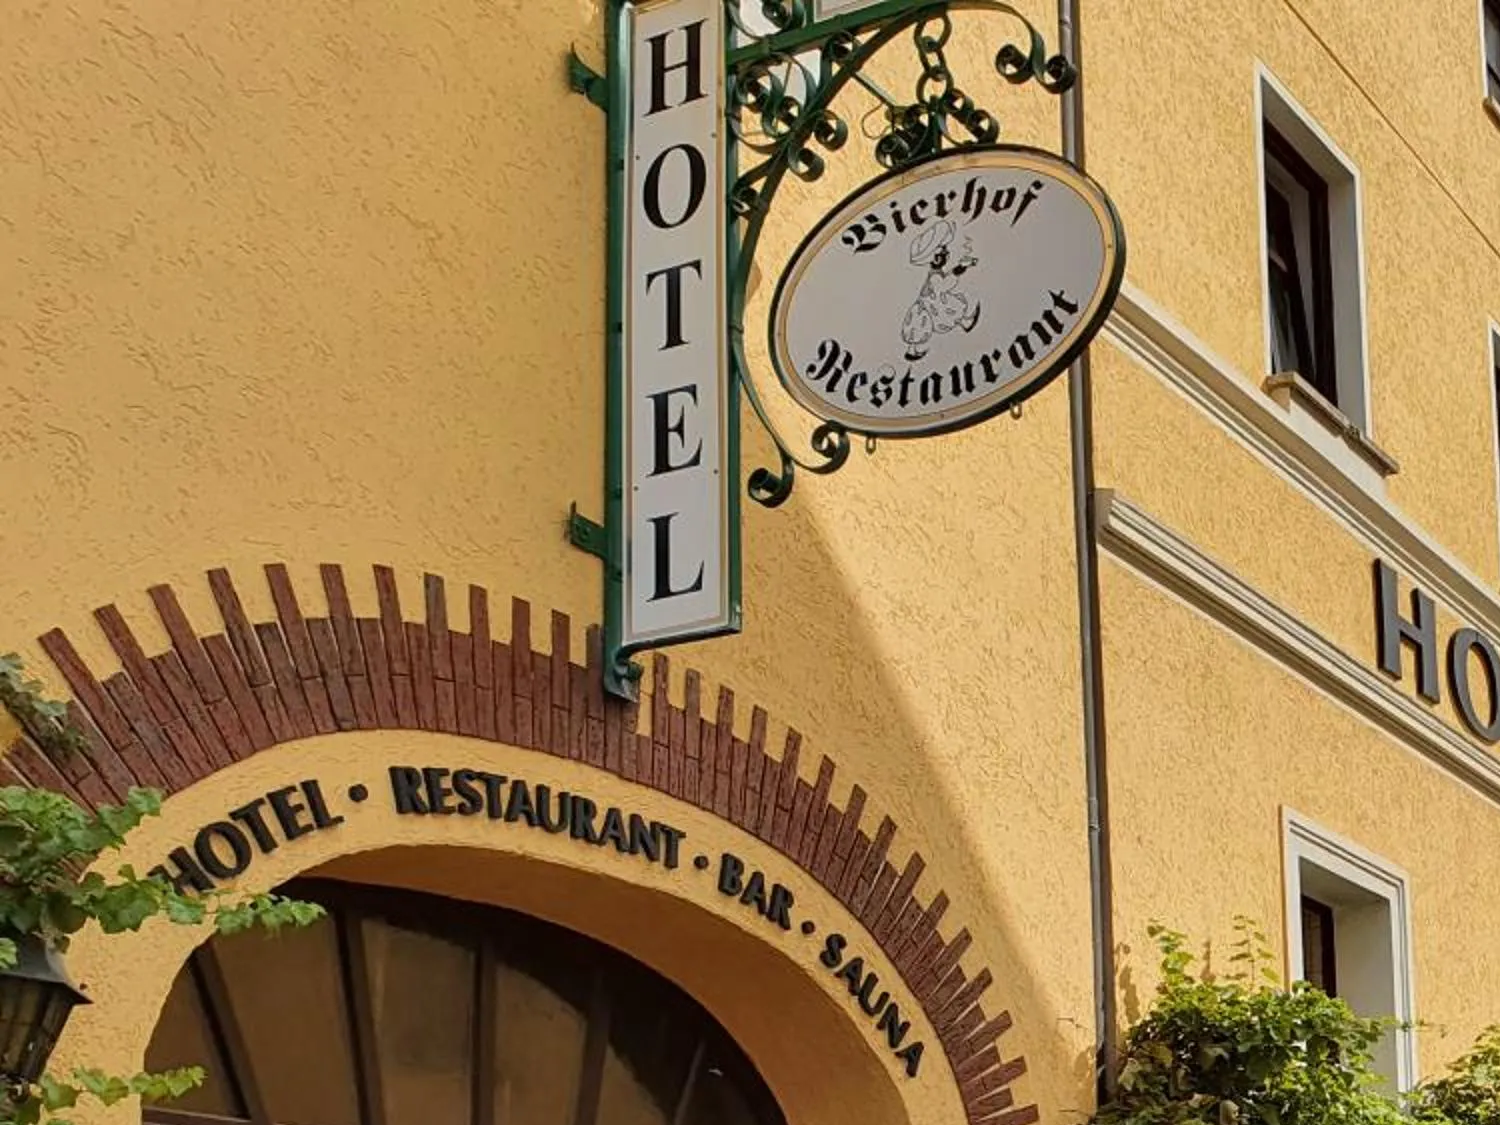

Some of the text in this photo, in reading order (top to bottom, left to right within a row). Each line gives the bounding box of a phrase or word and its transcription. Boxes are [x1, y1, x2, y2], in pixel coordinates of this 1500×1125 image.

[642, 18, 709, 602] HOTEL
[841, 175, 1044, 255] Bierhof
[805, 289, 1079, 409] Restaurant
[147, 766, 925, 1078] HOTEL RESTAURANT BAR SAUNA
